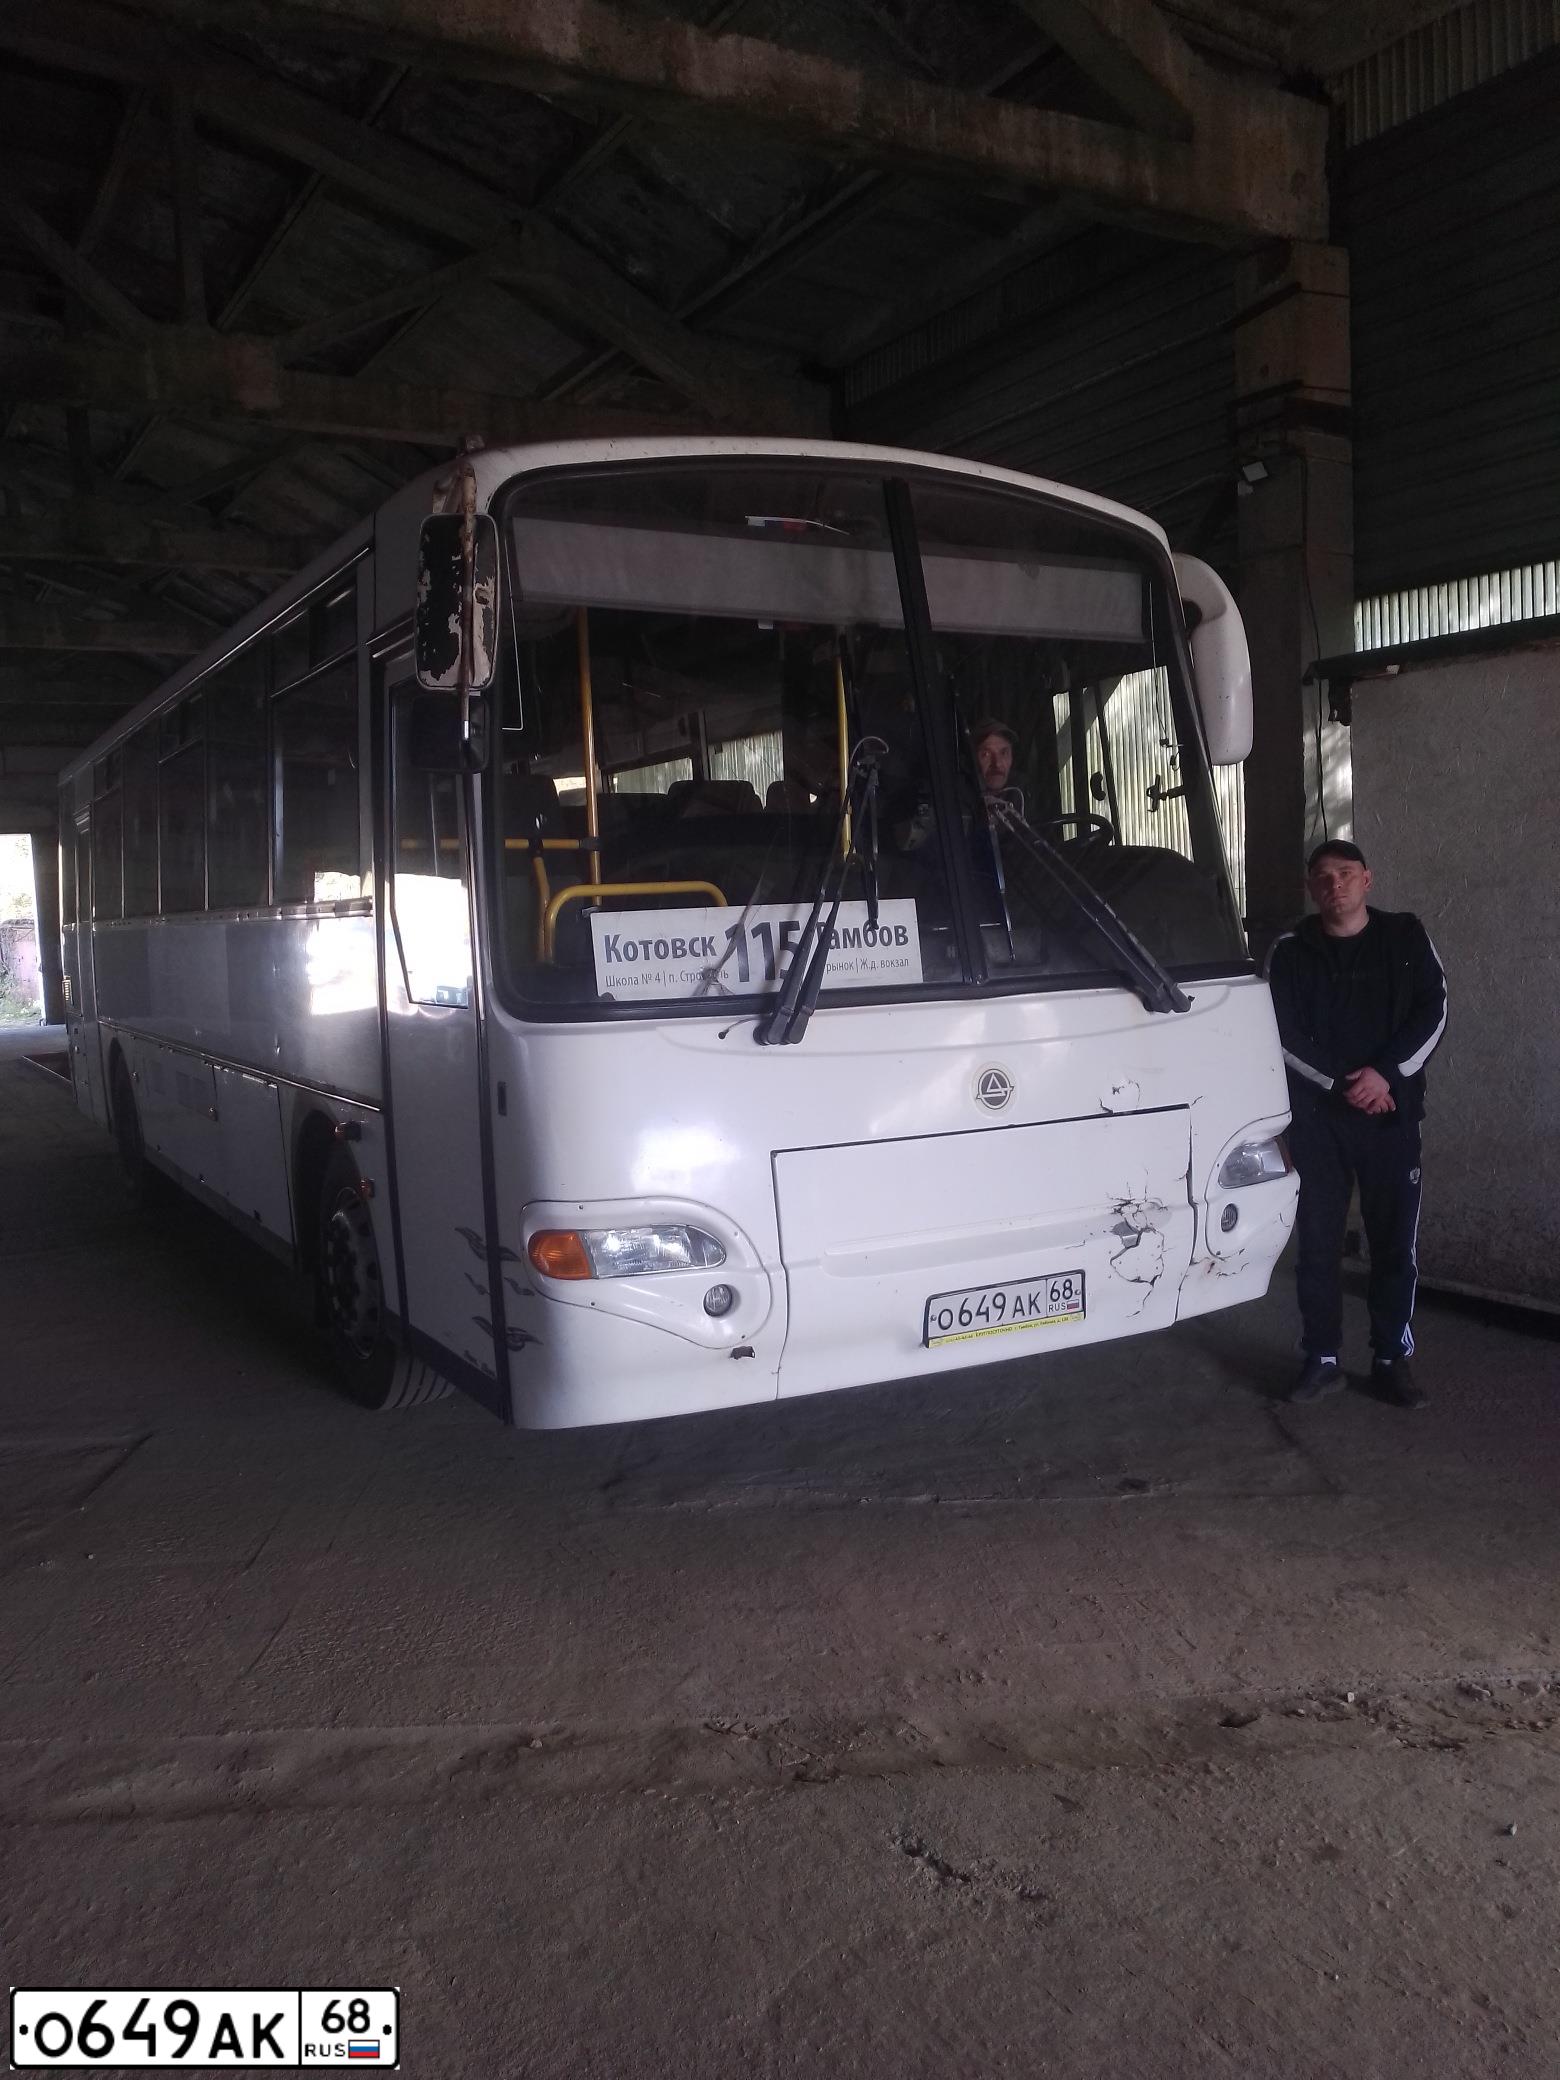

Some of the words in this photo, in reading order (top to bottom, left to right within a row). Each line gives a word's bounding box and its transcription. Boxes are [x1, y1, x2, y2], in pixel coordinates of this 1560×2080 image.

[604, 934, 717, 963] Котовск
[725, 920, 802, 983] 115
[826, 960, 854, 975] рынок
[880, 957, 909, 969] вокзал
[605, 975, 639, 987] Школа
[680, 969, 730, 983] Строь
[1050, 1279, 1073, 1302] 68
[1048, 1301, 1066, 1313] RUS
